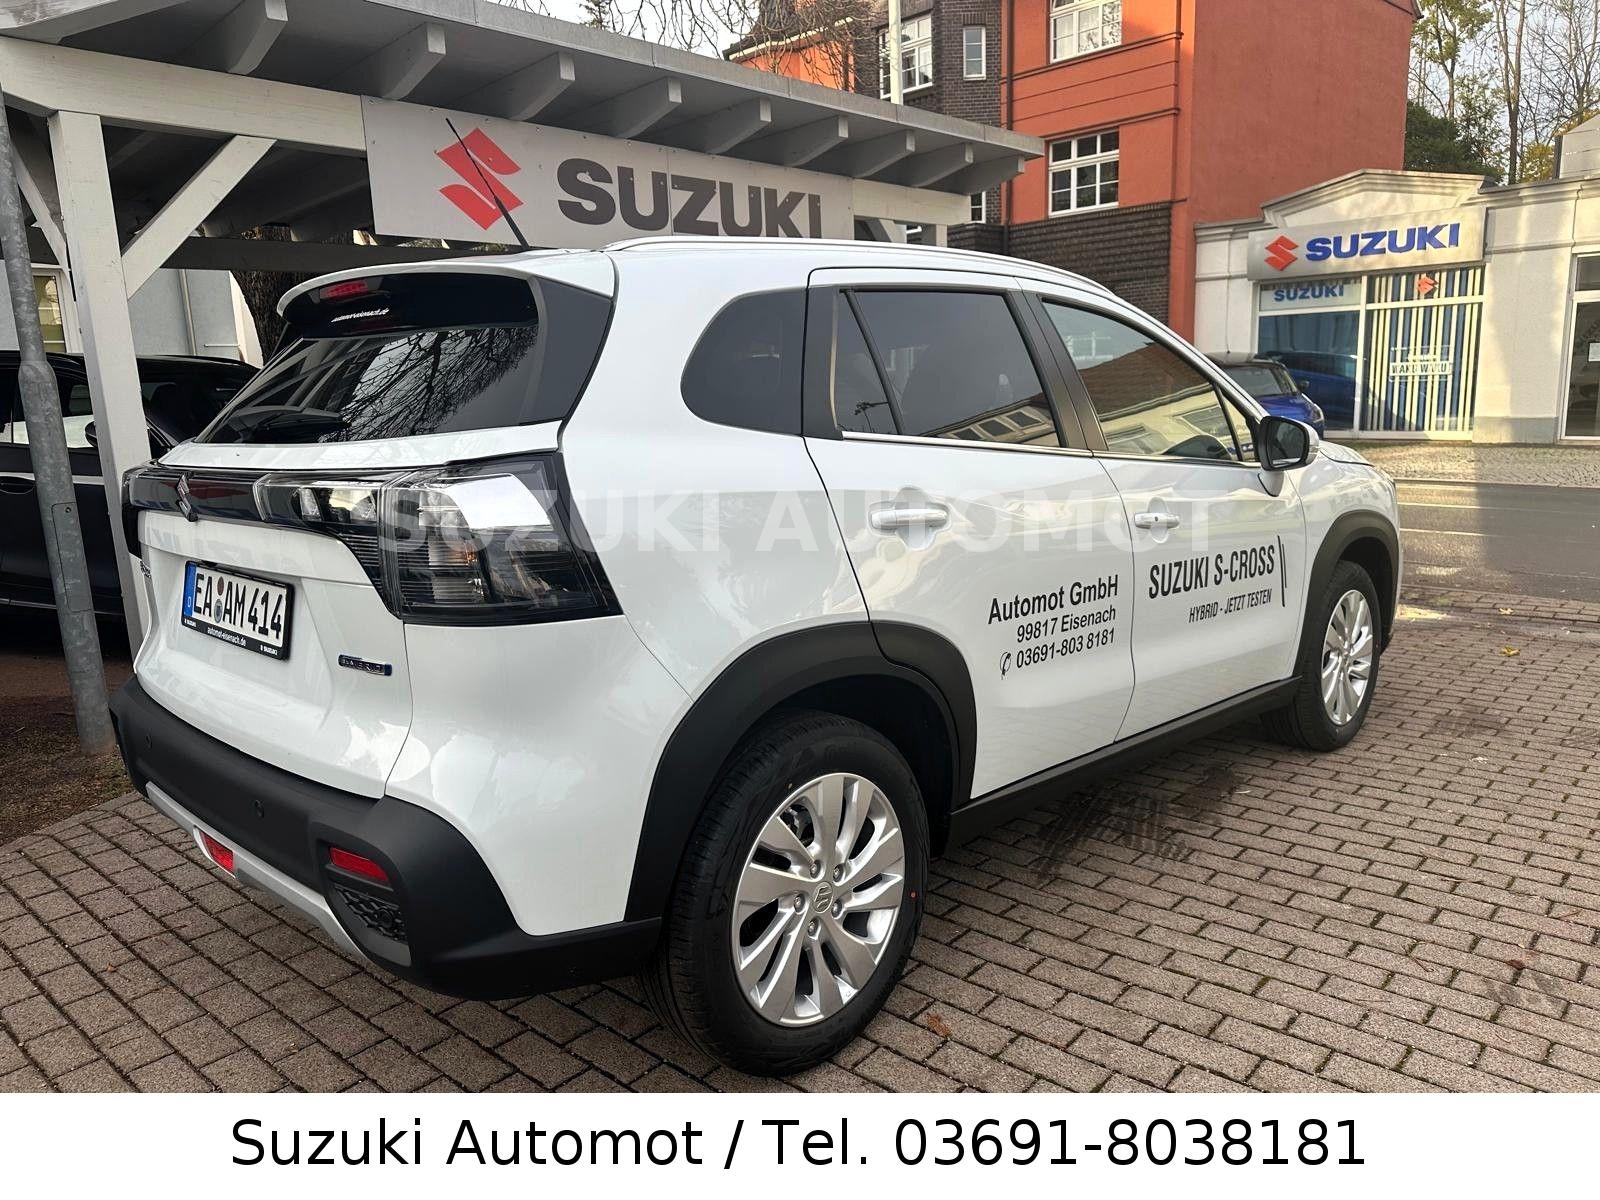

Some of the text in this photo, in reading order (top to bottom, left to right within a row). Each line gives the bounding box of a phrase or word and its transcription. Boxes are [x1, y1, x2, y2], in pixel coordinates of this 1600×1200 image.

[557, 158, 822, 238] SUZUKI
[1305, 222, 1460, 262] SUZUKI
[1274, 284, 1344, 302] SUZUKI
[1149, 544, 1275, 599] SUZUKI S-CROSS
[193, 573, 283, 640] EA AM 414
[988, 574, 1119, 624] Automot GmbH
[1188, 601, 1218, 624] HYBRID
[1224, 594, 1246, 615] JETZT
[1246, 588, 1273, 610] TESTEN
[1016, 605, 1116, 643] 99817 Eisenach
[1016, 627, 1115, 669] 03691-803 8181
